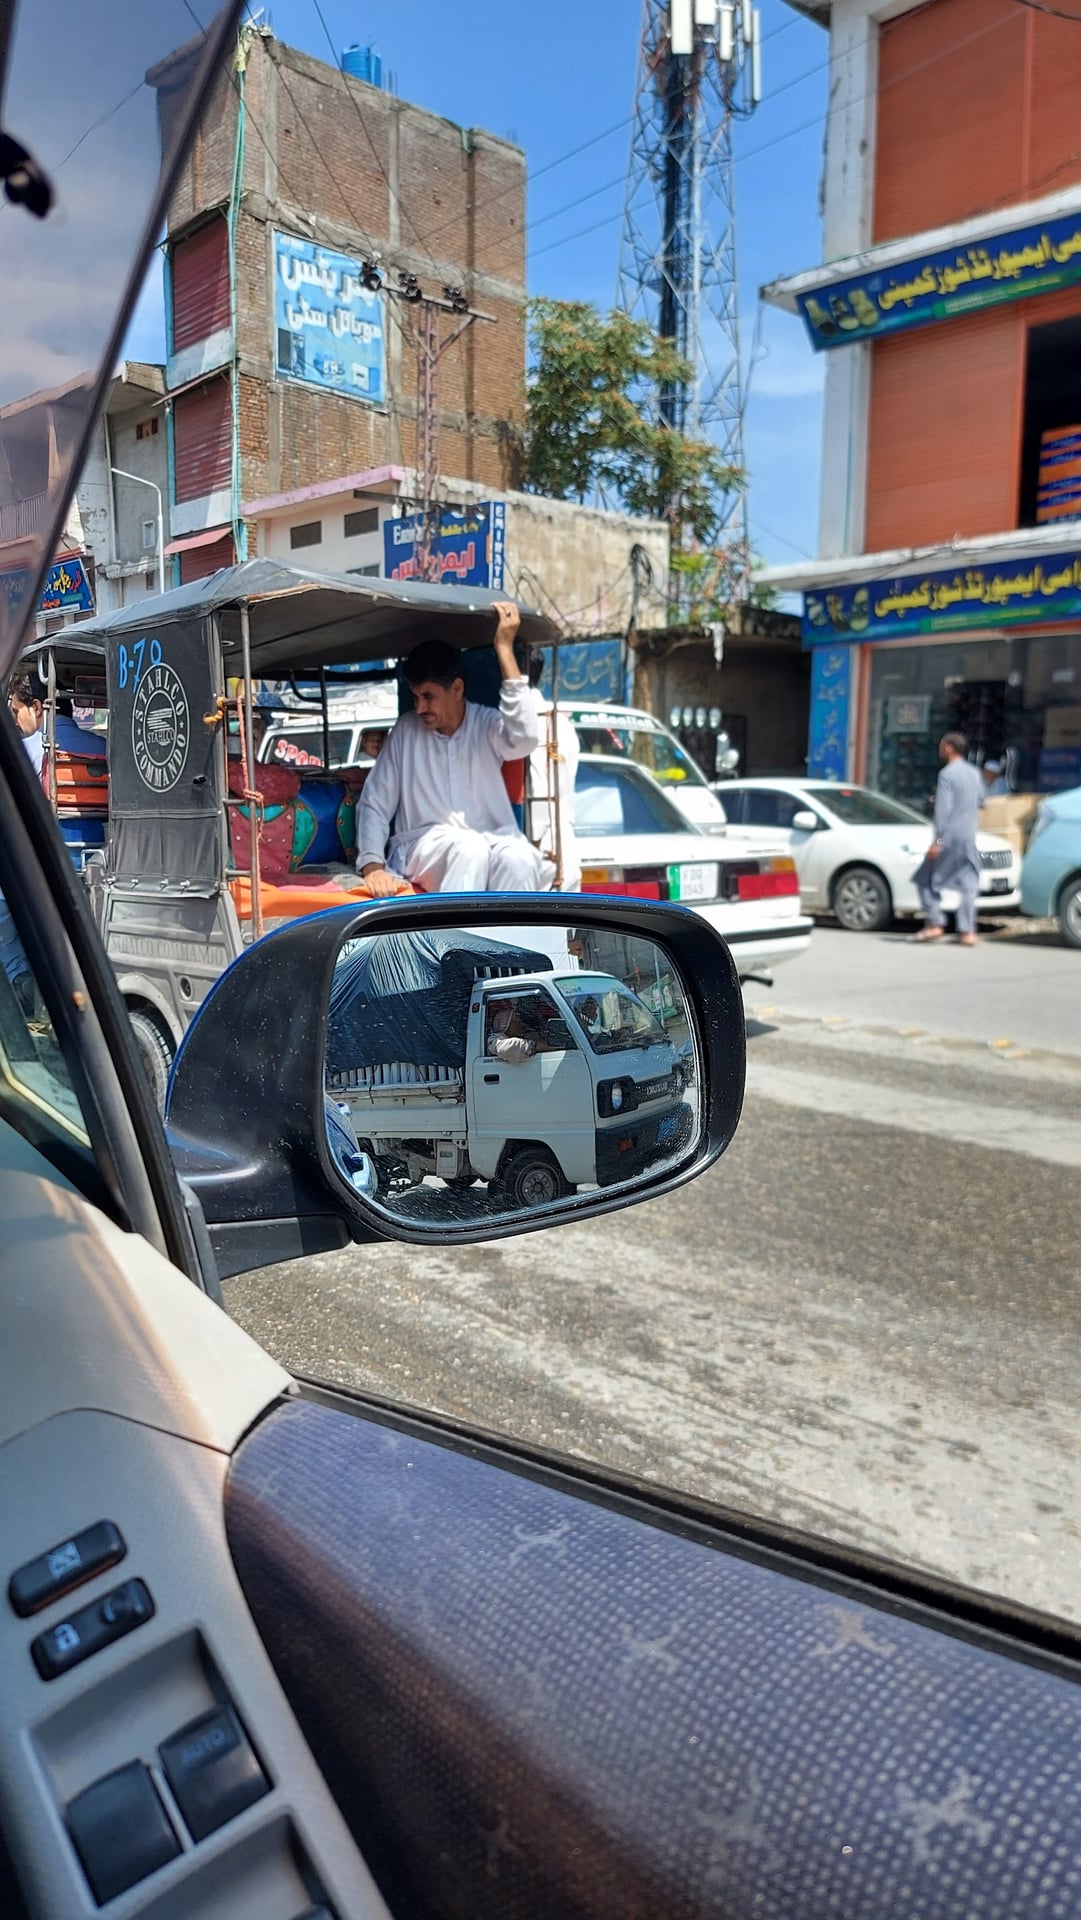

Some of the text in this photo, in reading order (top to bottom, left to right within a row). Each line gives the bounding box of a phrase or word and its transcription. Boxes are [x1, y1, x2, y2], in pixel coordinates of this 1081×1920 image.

[878, 266, 937, 310] کمپنی
[874, 580, 931, 618] کمپنی
[135, 667, 185, 722] STAHLCO
[147, 731, 175, 745] STAHLCO
[274, 738, 325, 769] SPOR
[135, 733, 186, 788] COMMANDO
